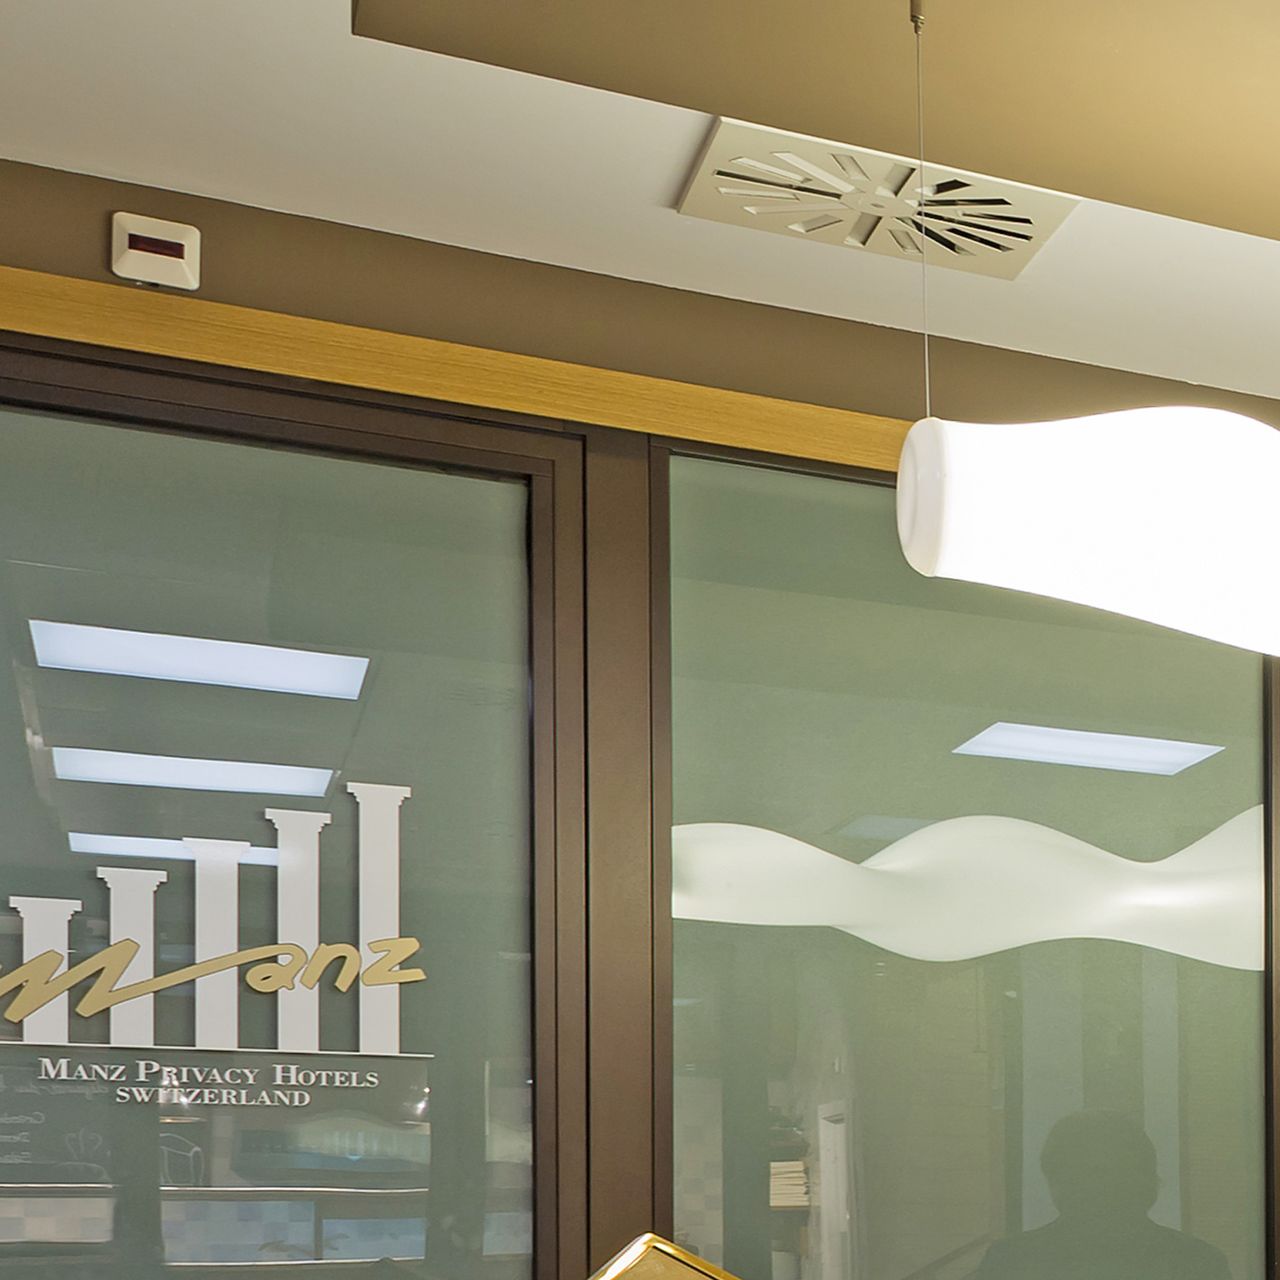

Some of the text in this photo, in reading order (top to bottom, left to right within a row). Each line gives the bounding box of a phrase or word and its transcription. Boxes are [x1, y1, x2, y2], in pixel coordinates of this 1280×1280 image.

[37, 1057, 380, 1089] MANZ PRIVACY HOTELS
[115, 1086, 312, 1108] SWITZERLAND
